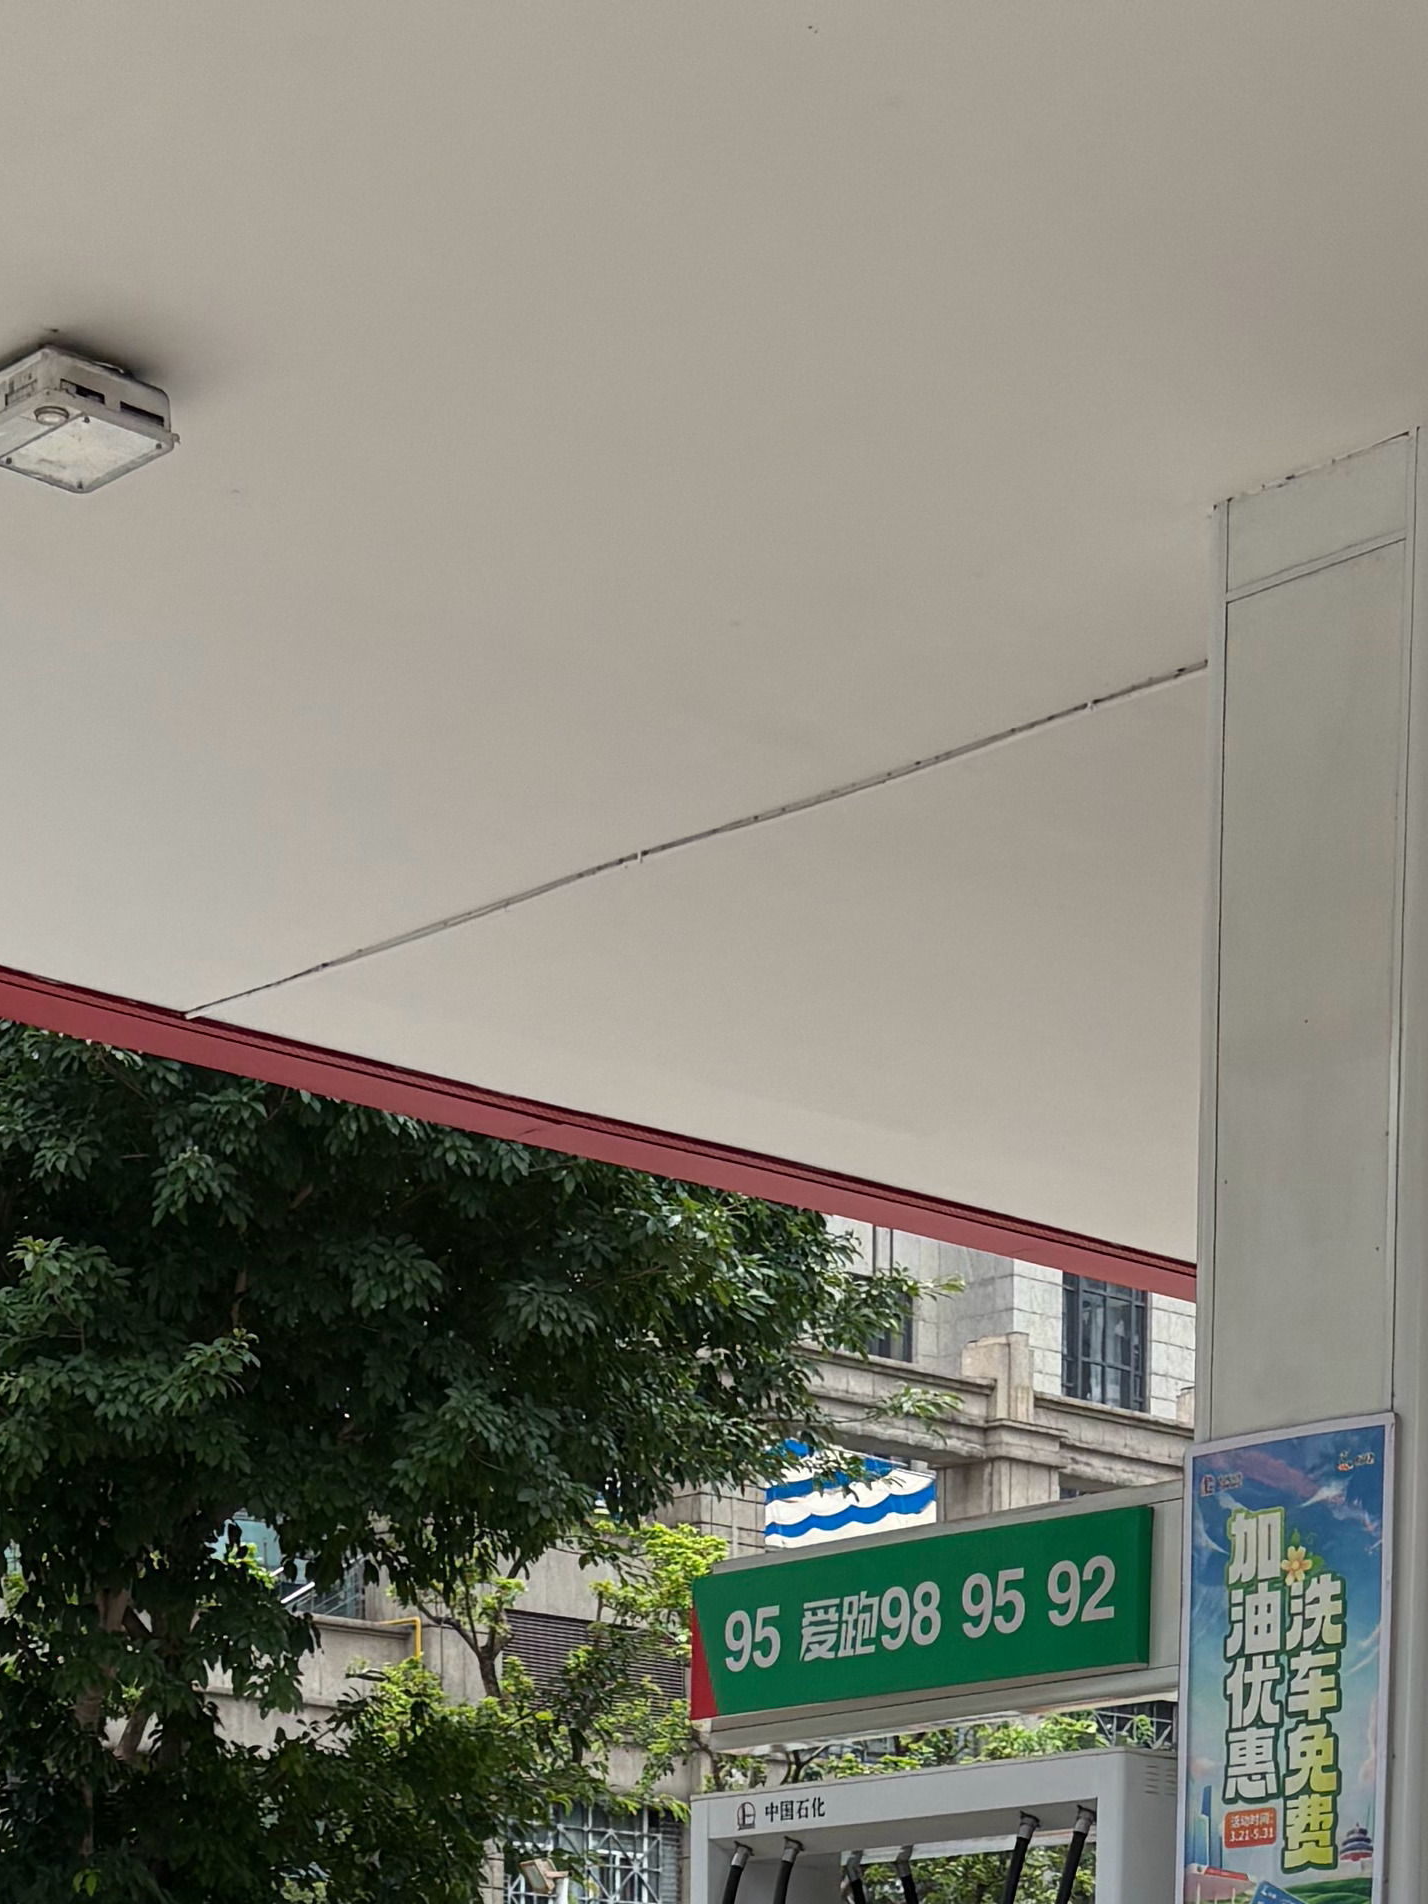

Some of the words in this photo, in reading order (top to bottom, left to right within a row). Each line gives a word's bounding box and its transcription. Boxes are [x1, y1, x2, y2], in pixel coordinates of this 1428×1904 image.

[724, 1605, 781, 1673] 95
[961, 1567, 1026, 1639] 95
[1047, 1555, 1116, 1628] 92
[1225, 1511, 1283, 1800] 加油优惠
[765, 1796, 825, 1823] 中国石化
[1283, 1572, 1343, 1870] 洗车免费
